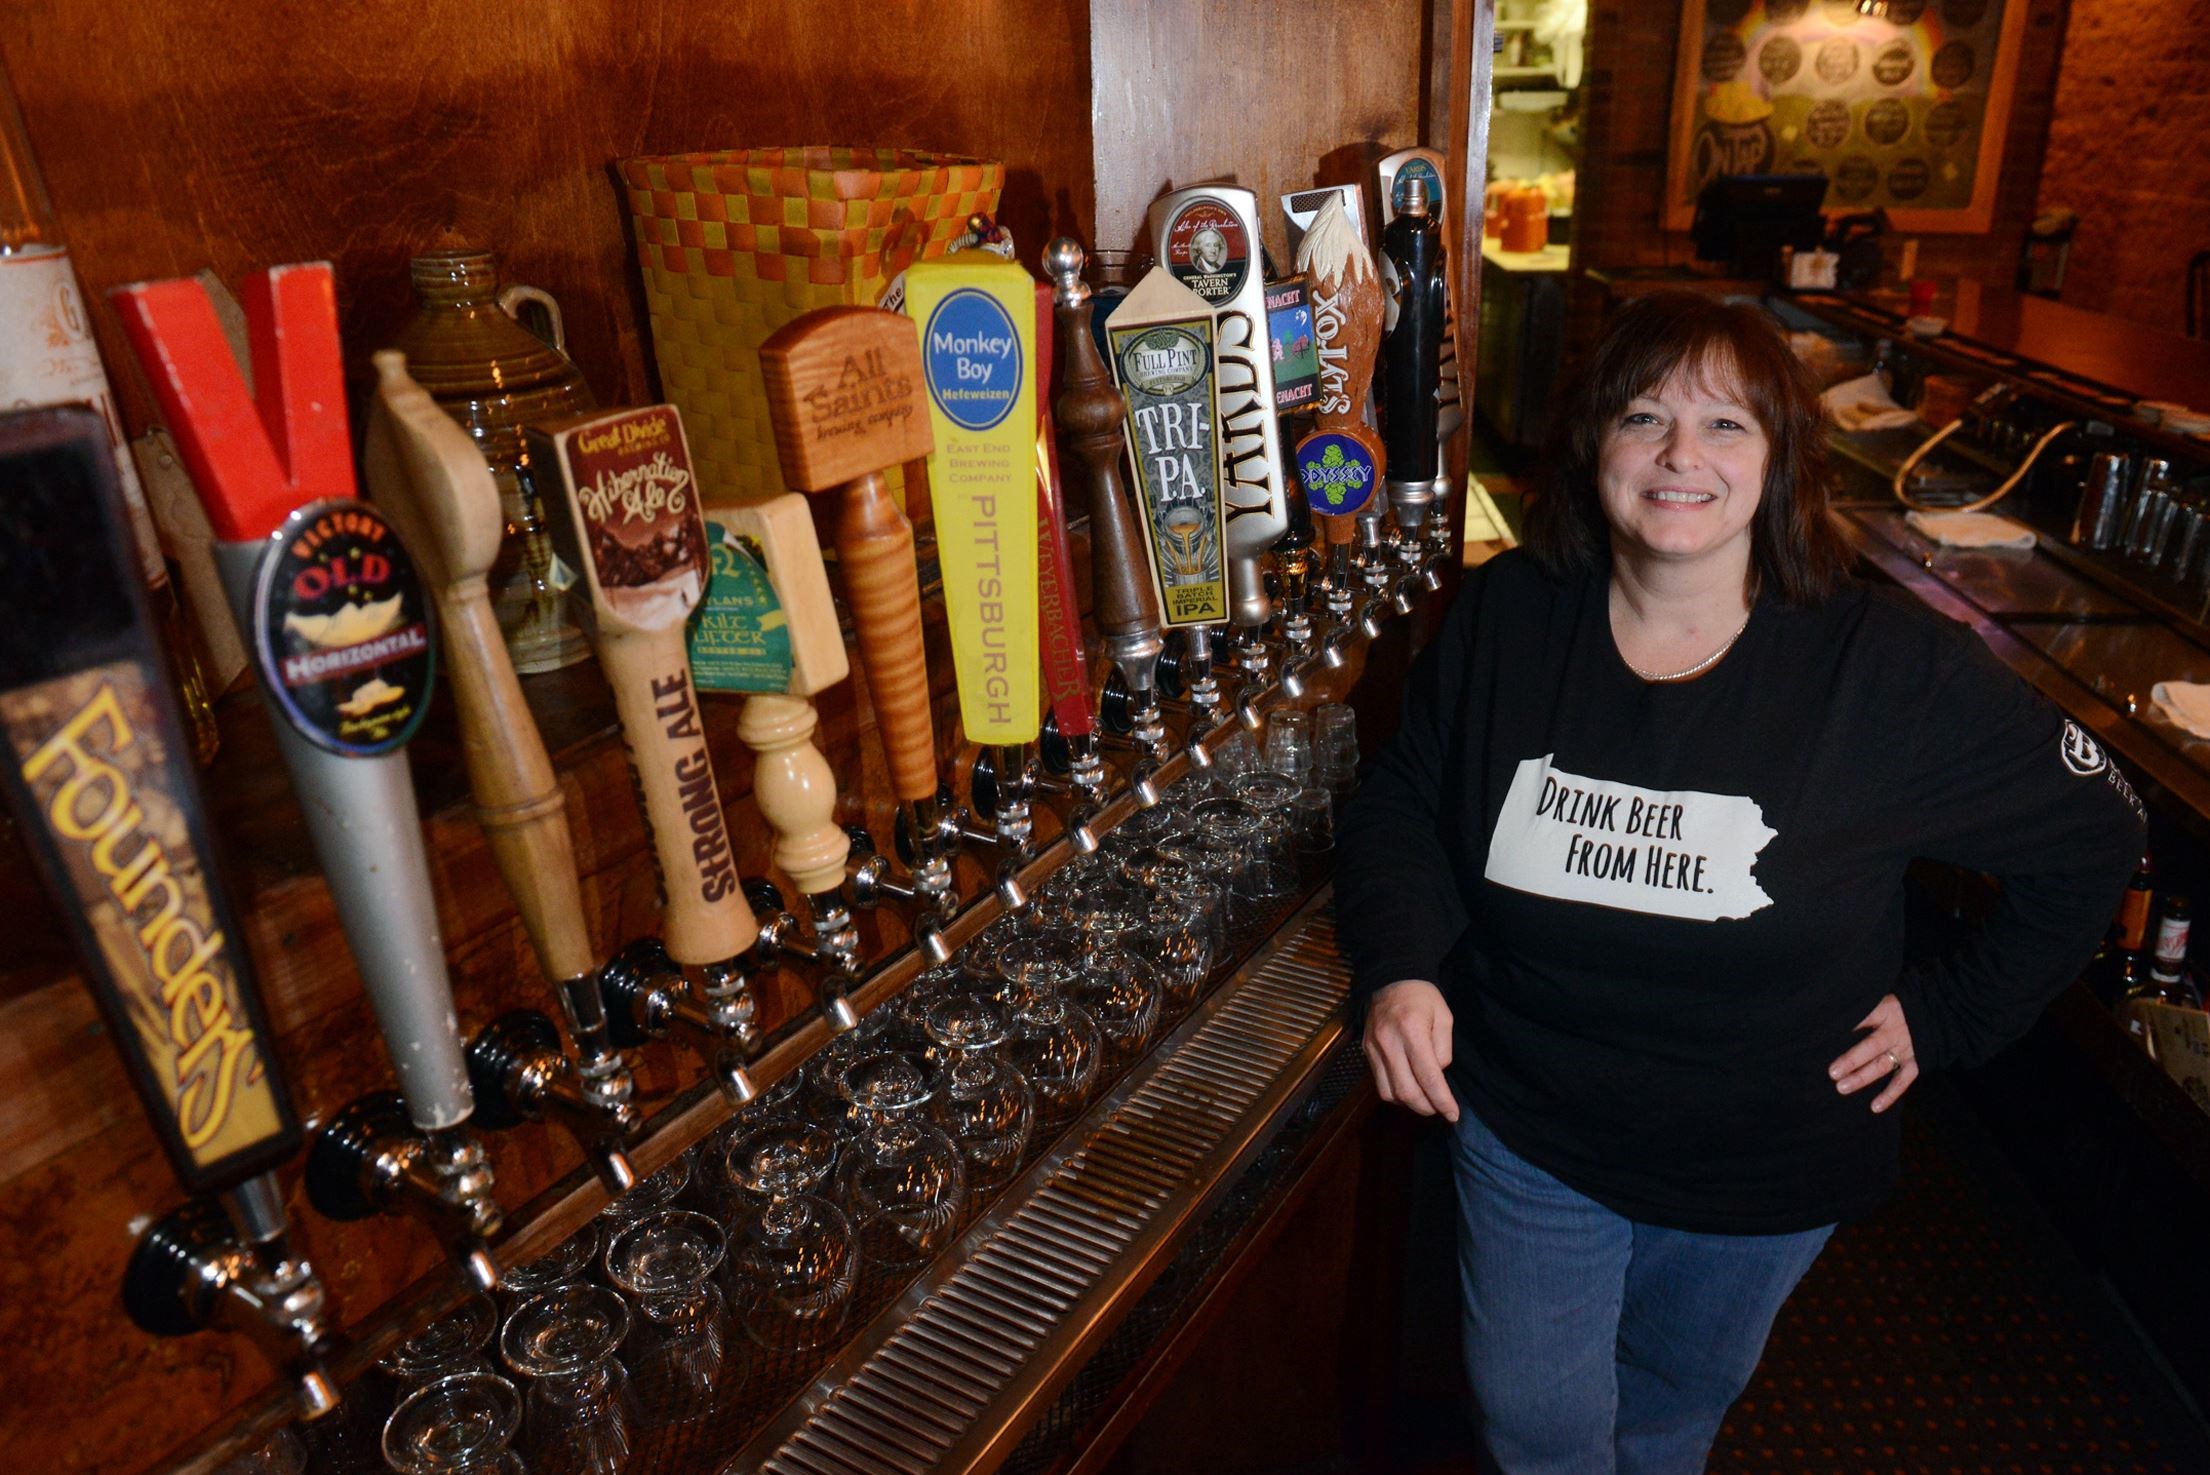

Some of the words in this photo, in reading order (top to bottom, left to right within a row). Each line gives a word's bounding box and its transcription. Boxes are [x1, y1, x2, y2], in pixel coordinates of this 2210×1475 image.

[1192, 277, 1229, 288] TAVERN
[1265, 289, 1301, 309] NACHT
[838, 346, 888, 389] All
[933, 330, 1012, 360] Monkey
[1133, 351, 1167, 373] FULL
[1166, 348, 1197, 368] PINT
[956, 356, 993, 385] Boy
[803, 375, 913, 424] Saints
[942, 388, 1010, 400] Hefeweizen
[1276, 383, 1313, 404] ENACHT
[946, 443, 979, 454] EAST
[983, 443, 1011, 453] END
[1134, 402, 1211, 455] TRI-
[949, 472, 1012, 484] COMPANY
[950, 459, 1010, 469] BREWING
[578, 450, 690, 525] Hibernation
[621, 480, 667, 525] Ale
[292, 511, 387, 559] VICTORY
[293, 553, 392, 600] OLD
[1175, 585, 1214, 594] TRIPLE
[971, 494, 1012, 725] PITTSBURGH
[1037, 517, 1081, 702] WEYERBACHER
[1176, 602, 1216, 616] IPA
[285, 626, 428, 682] HORIZONTAL
[651, 668, 702, 740] ALE
[674, 747, 737, 904] STRONG
[1535, 776, 1623, 832] DRINK
[1625, 795, 1685, 841] BEER
[1564, 833, 1638, 884] FROM
[1644, 845, 1715, 894] HERE.
[22, 682, 265, 1149] Founders
